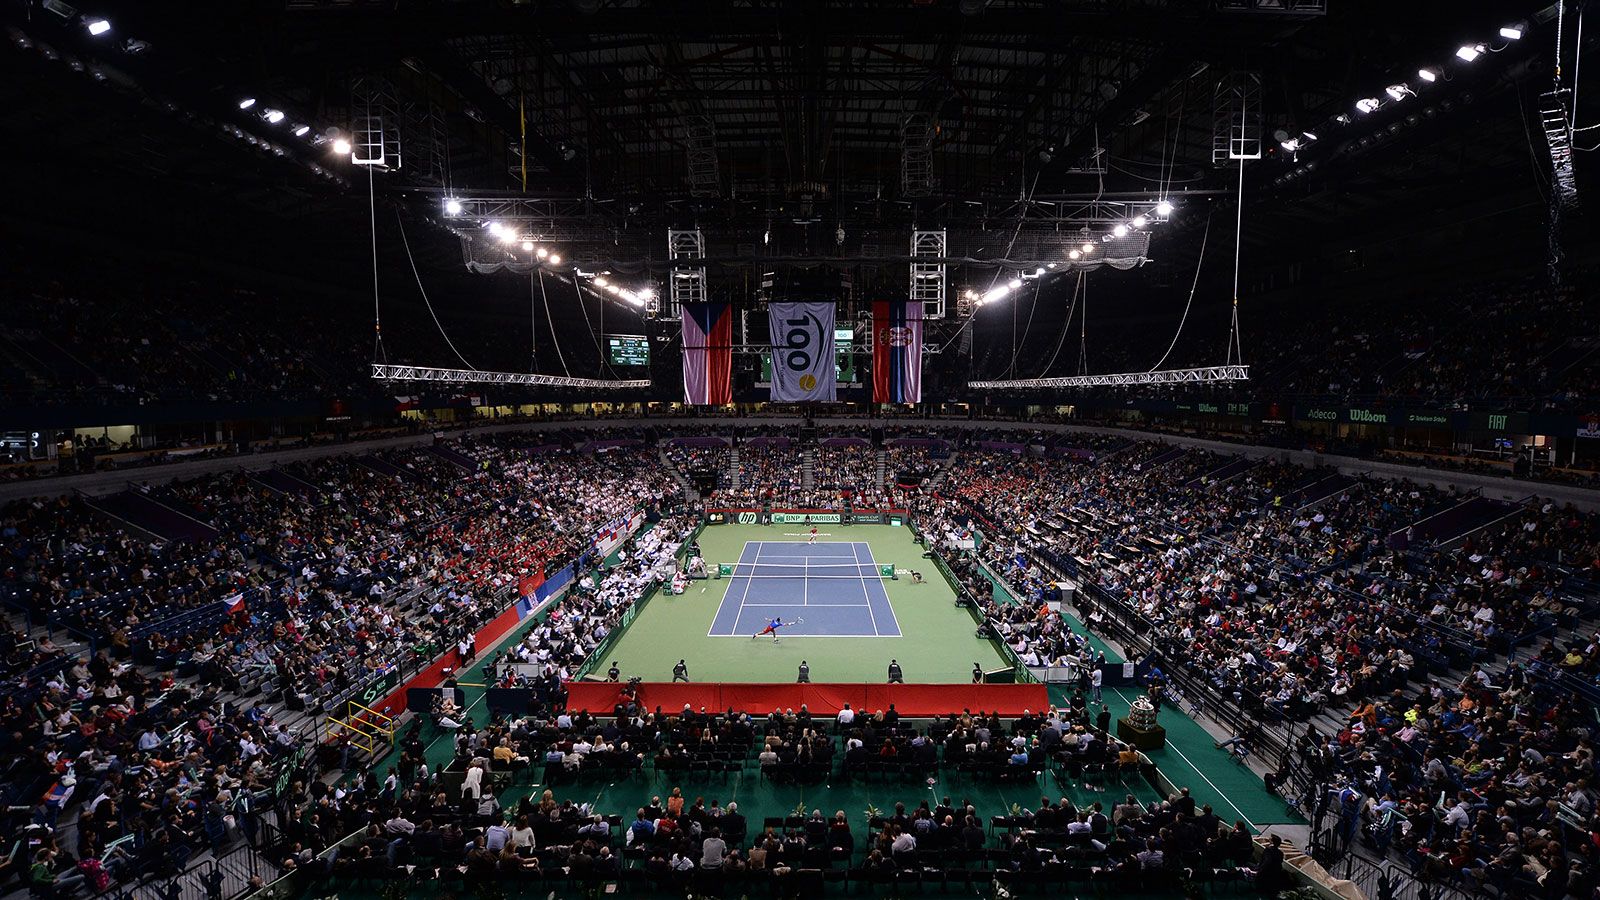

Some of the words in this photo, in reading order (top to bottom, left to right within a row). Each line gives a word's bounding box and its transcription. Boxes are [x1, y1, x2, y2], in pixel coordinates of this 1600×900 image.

[786, 315, 811, 372] 100
[1307, 408, 1337, 420] Adecco
[1349, 408, 1387, 423] Wilson
[1488, 414, 1508, 430] FIAT
[740, 512, 755, 524] hp
[785, 514, 800, 522] BNP
[810, 513, 840, 522] PARIBAS
